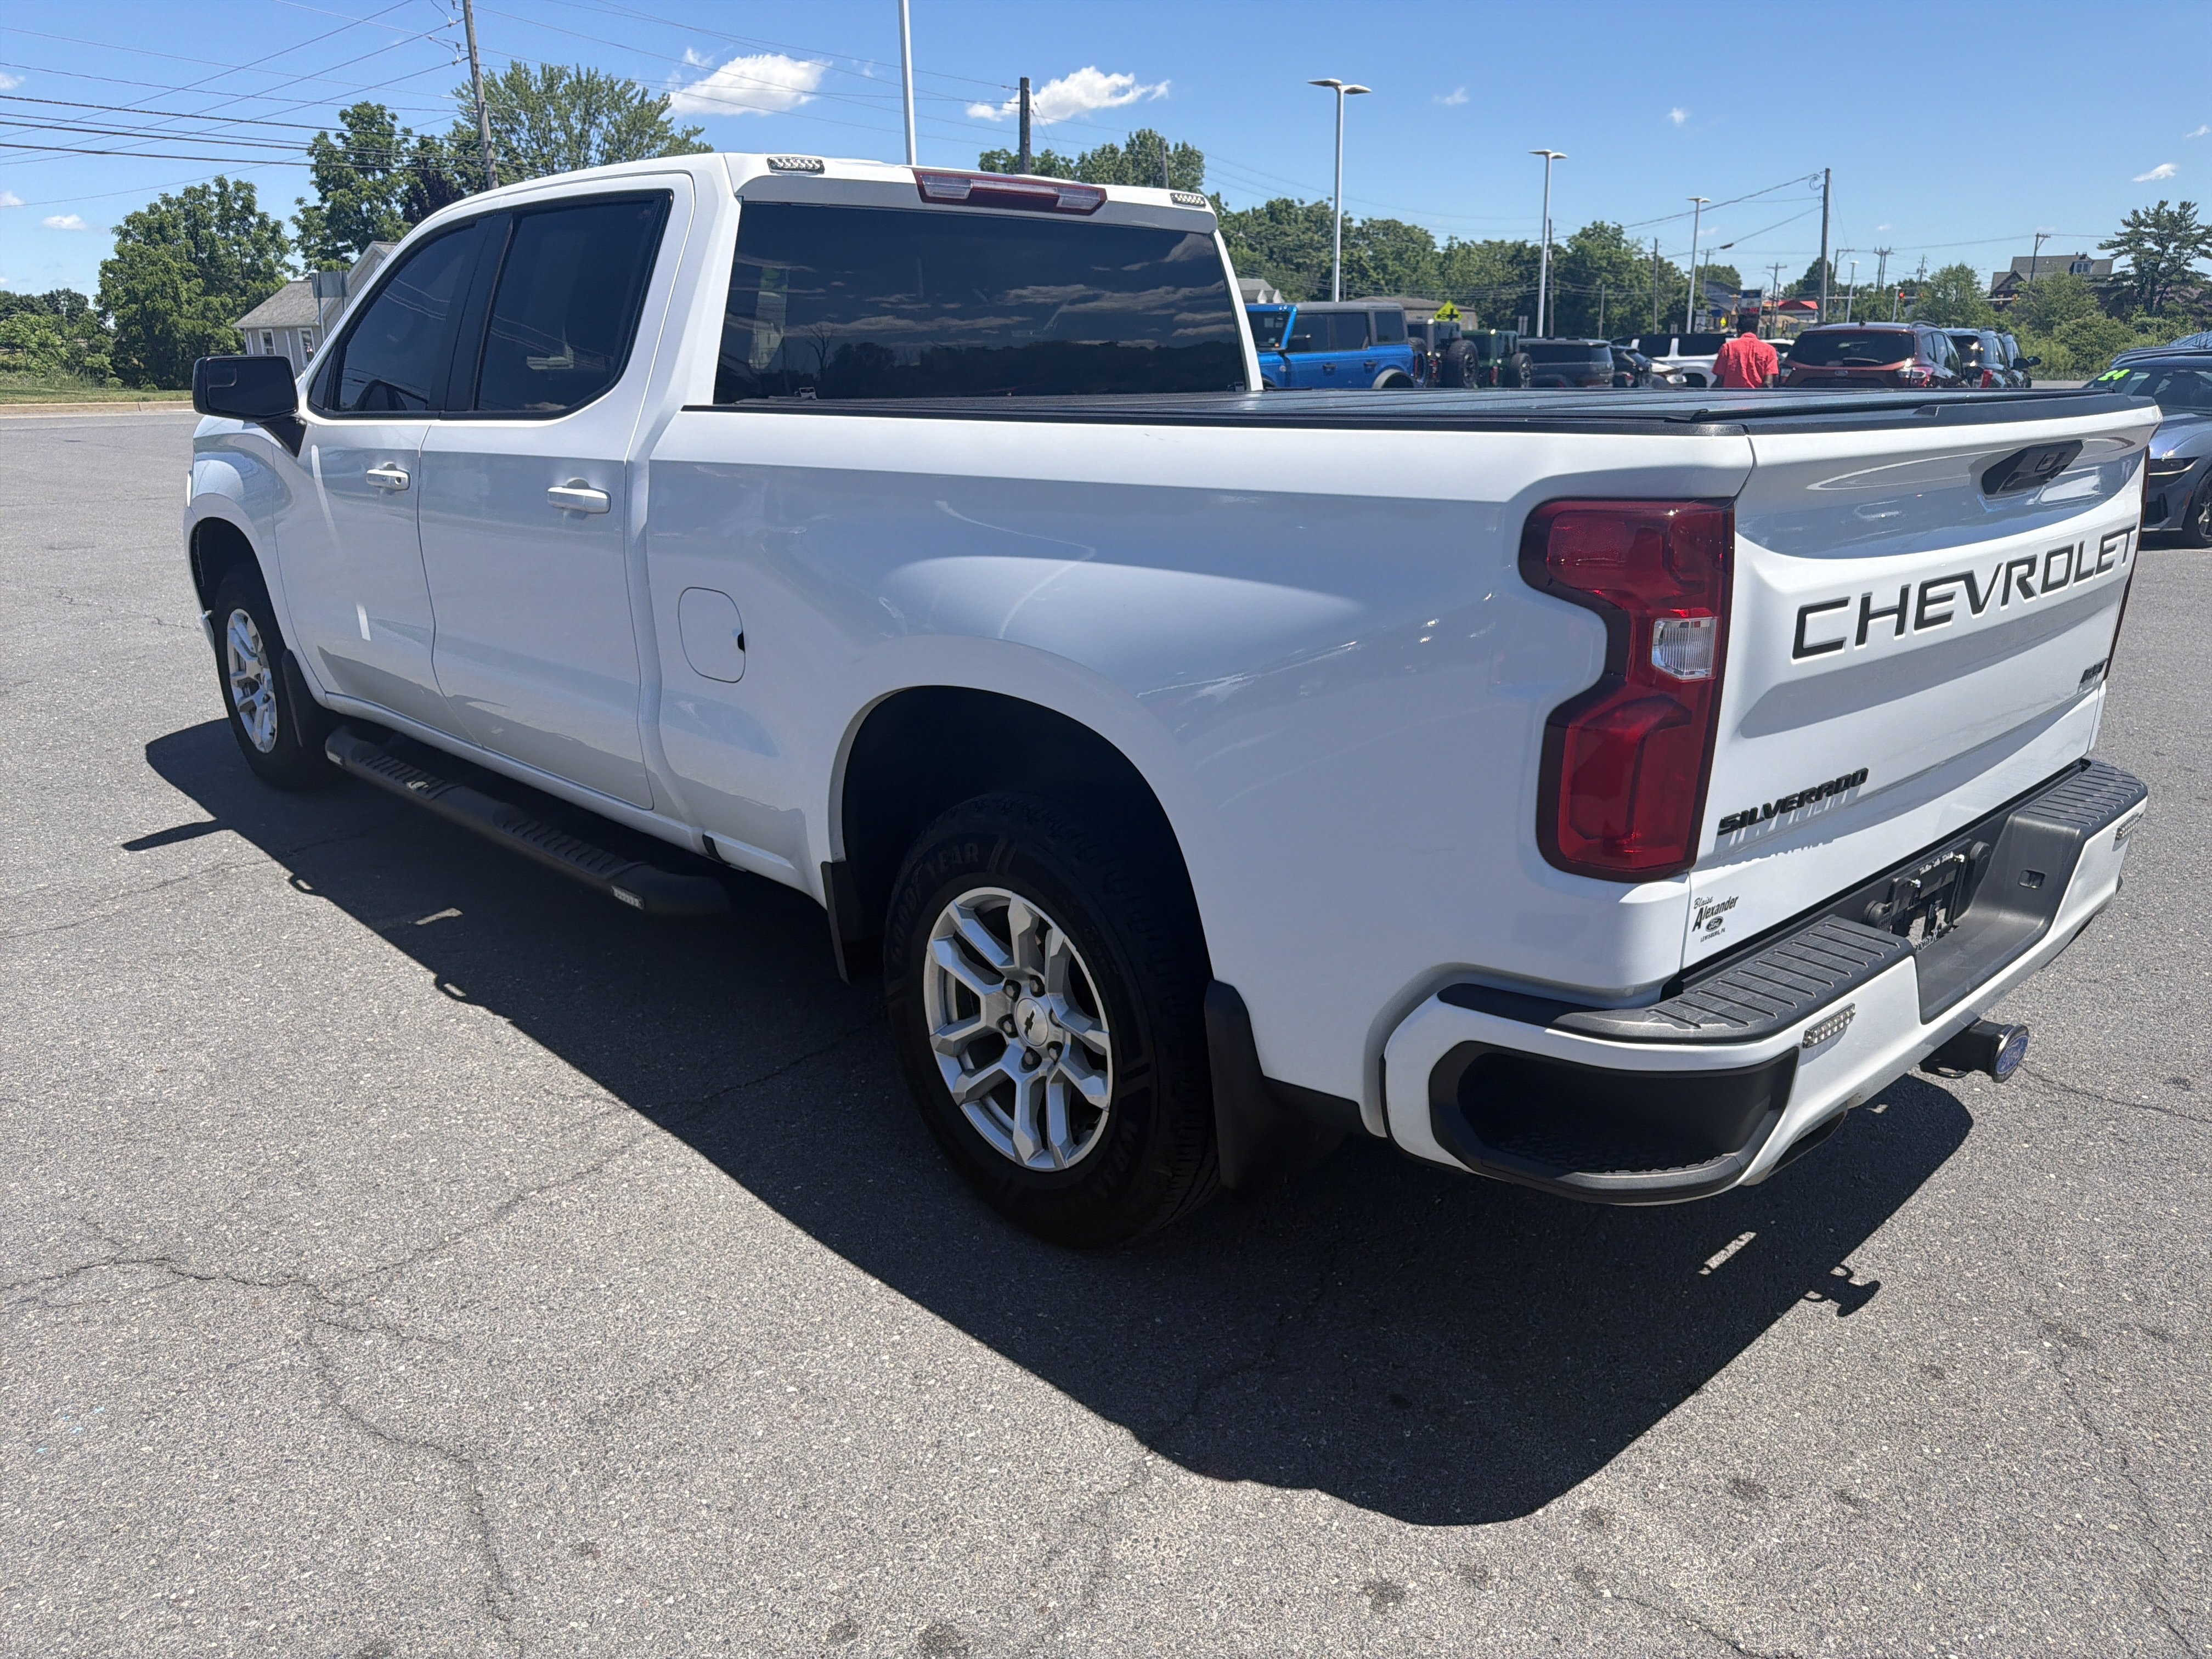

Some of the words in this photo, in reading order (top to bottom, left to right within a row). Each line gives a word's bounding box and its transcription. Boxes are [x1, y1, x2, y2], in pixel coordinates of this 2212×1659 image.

[1792, 525, 2136, 661] CHEVROLET
[1718, 768, 1869, 836] SILVERADO
[1692, 896, 1739, 932] Alexander
[1694, 896, 1713, 909] Blaise
